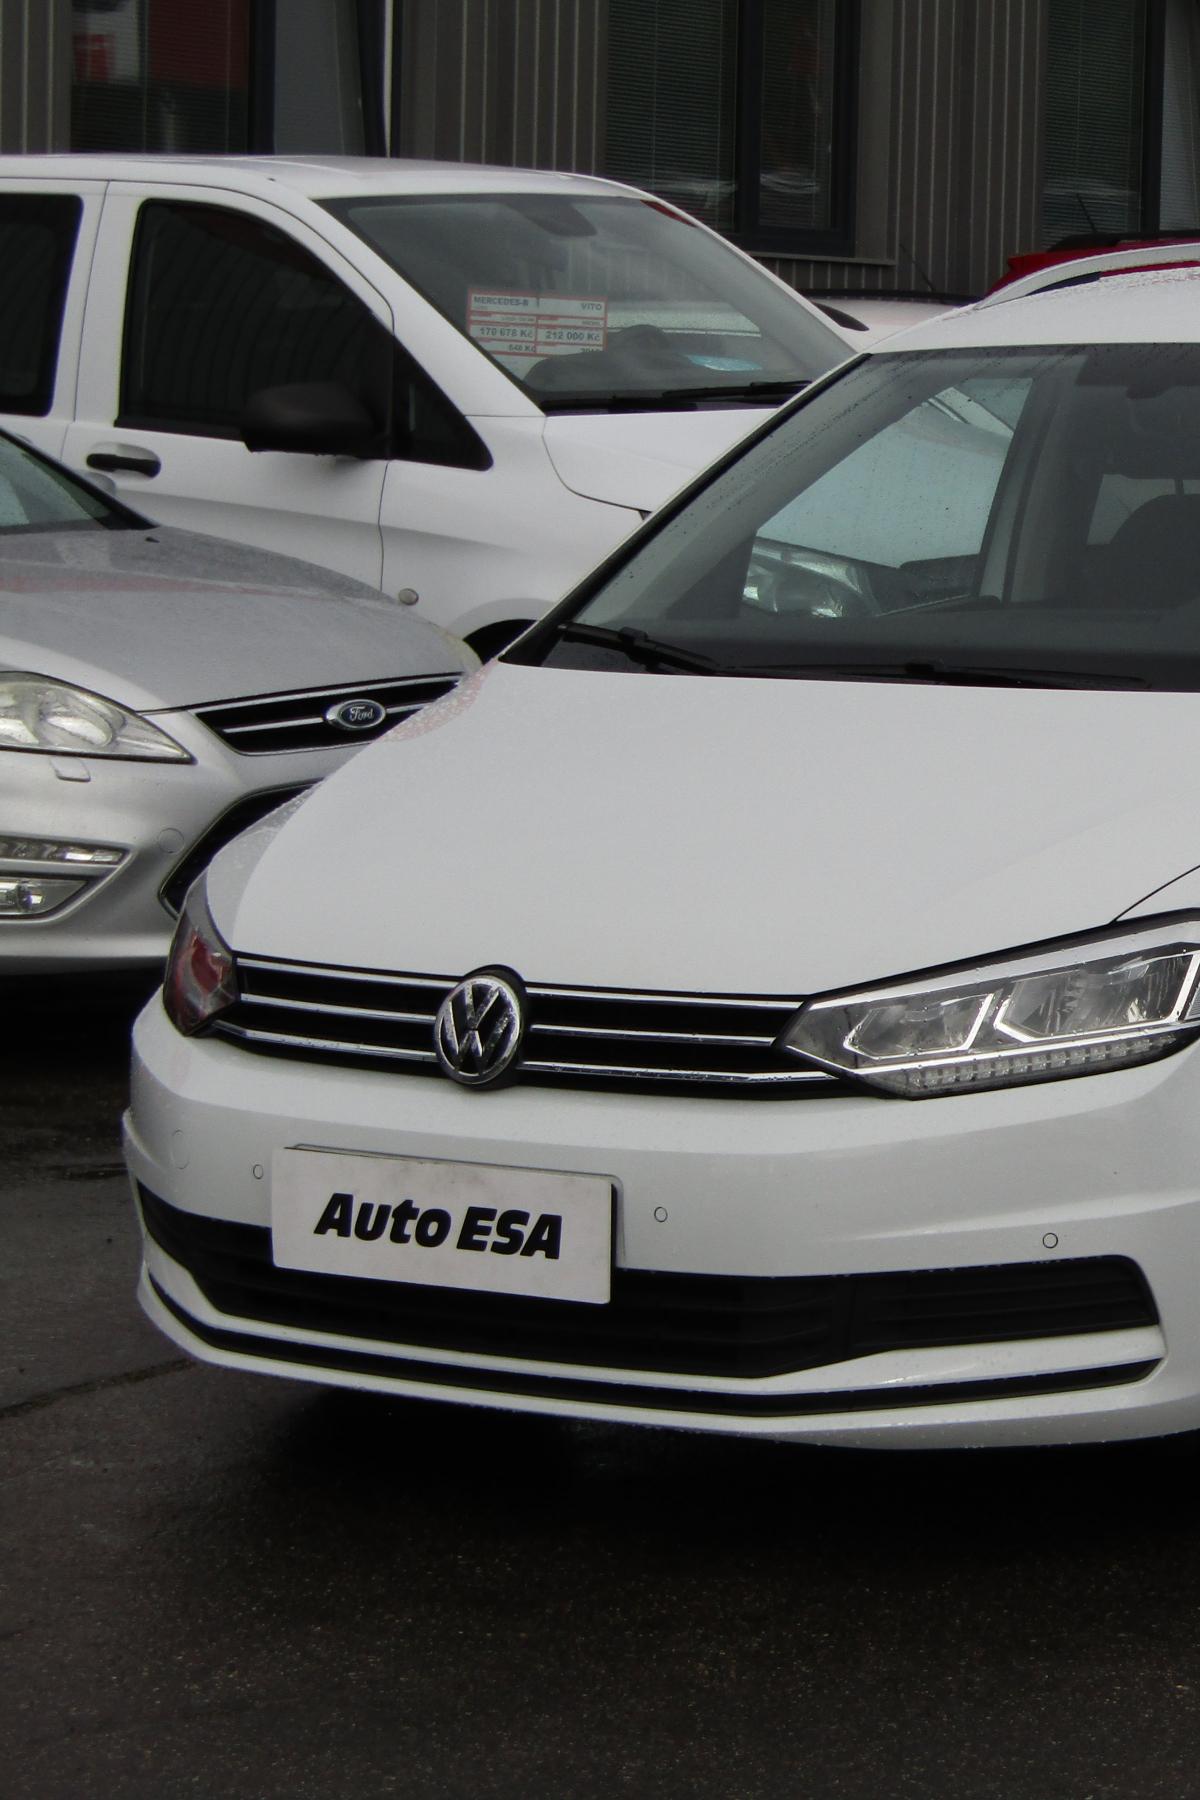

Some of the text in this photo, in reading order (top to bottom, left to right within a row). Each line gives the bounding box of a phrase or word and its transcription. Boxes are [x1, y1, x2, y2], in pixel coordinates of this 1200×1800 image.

[581, 303, 602, 311] VITO
[349, 706, 375, 722] Ford
[313, 1192, 563, 1260] Auto ESA
